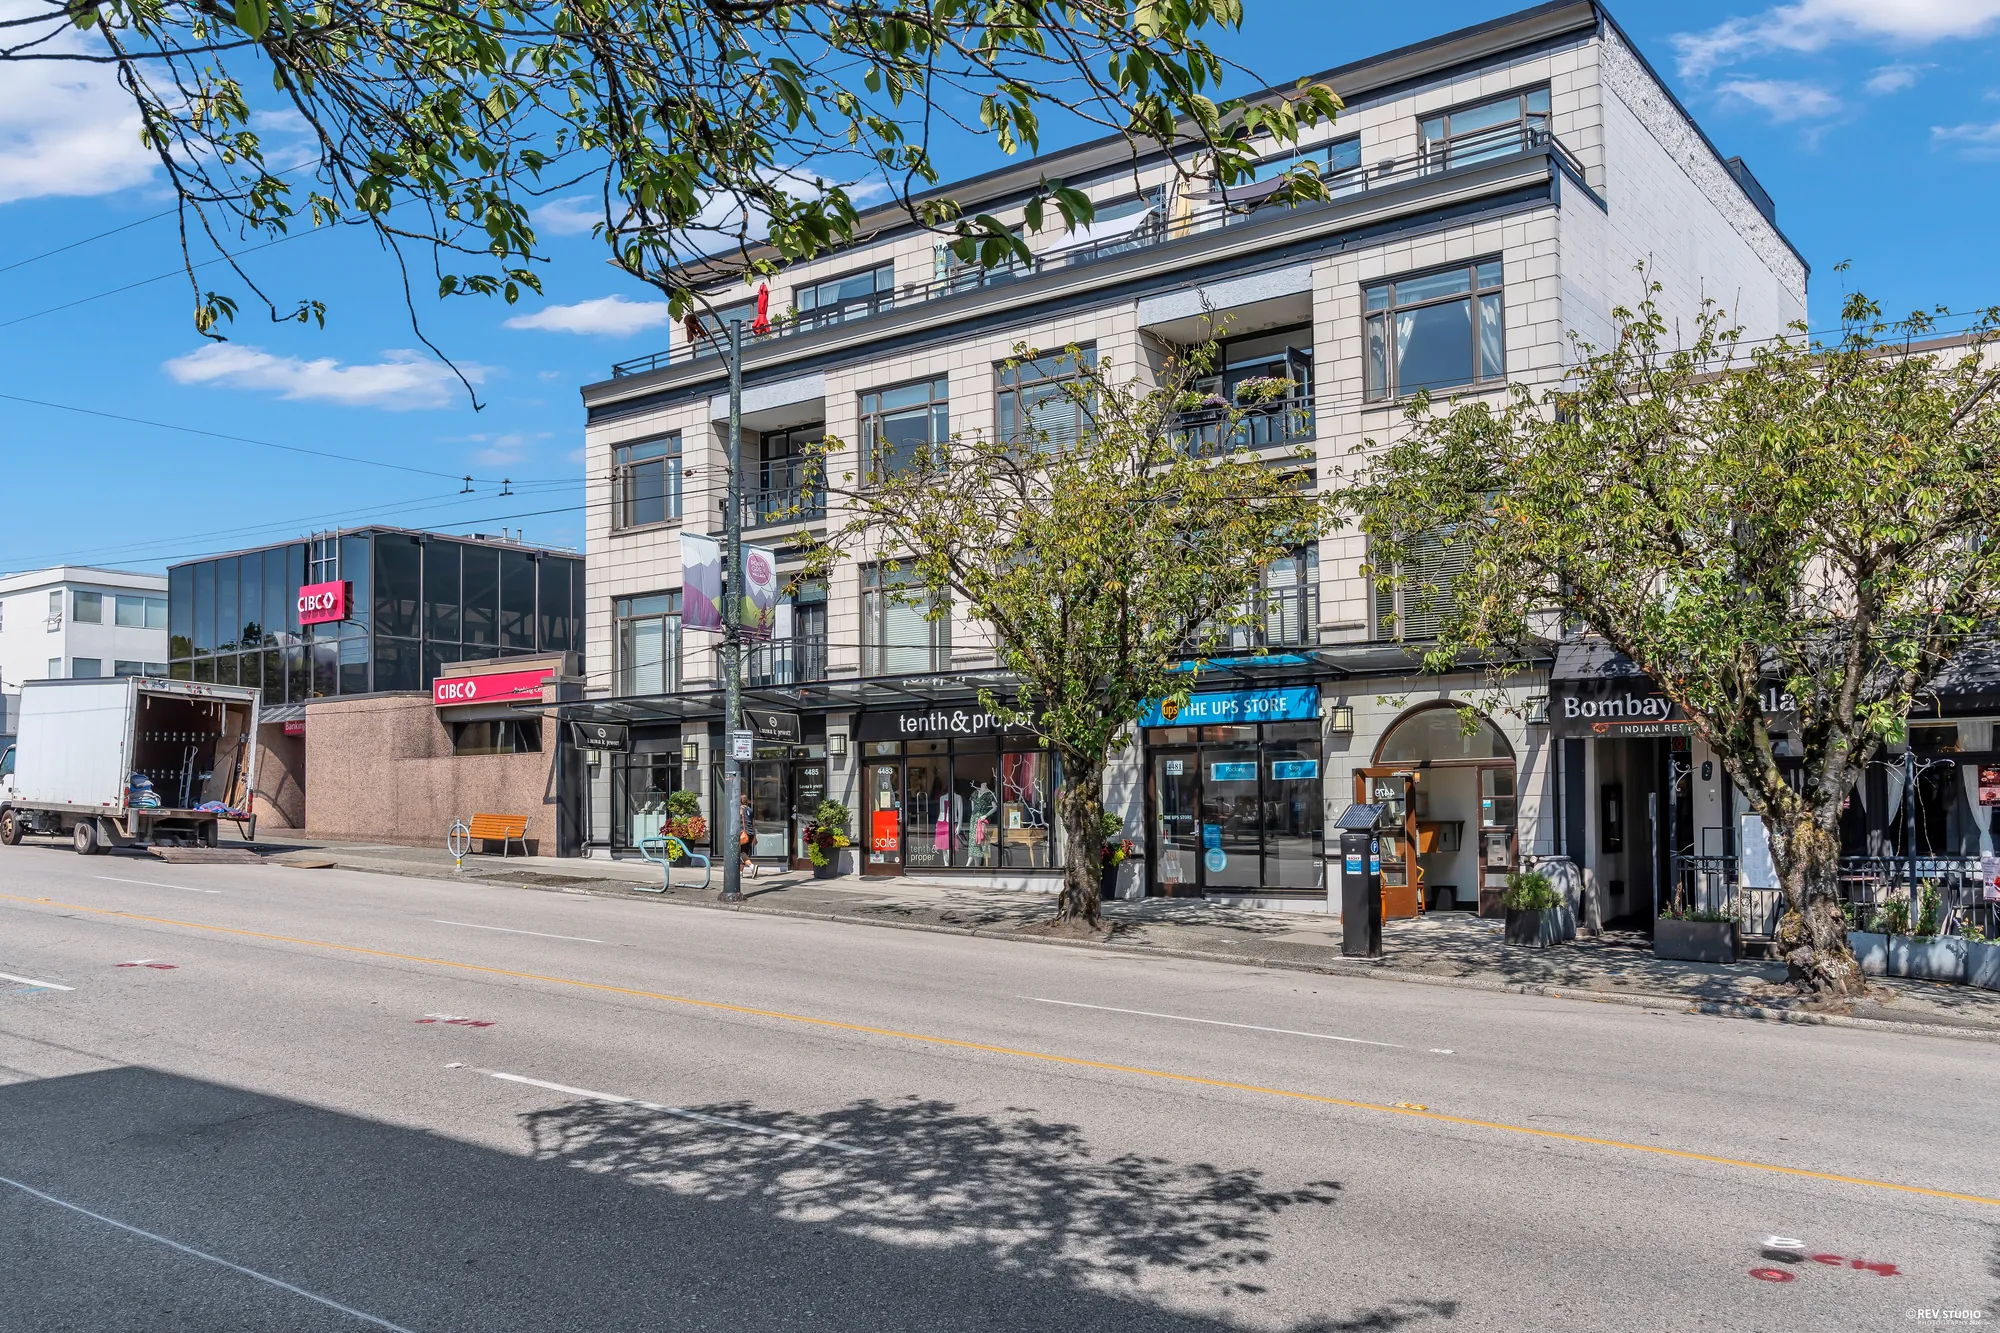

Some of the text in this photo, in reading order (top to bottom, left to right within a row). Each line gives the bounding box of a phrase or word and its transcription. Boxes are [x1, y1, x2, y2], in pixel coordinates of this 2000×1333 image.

[297, 594, 322, 612] CIBC
[438, 683, 464, 699] CIBC
[1163, 705, 1178, 718] ups
[1212, 701, 1239, 716] UPS
[1243, 697, 1287, 714] STORE
[1563, 693, 1672, 721] Bombay
[1620, 724, 1659, 734] INDIAN
[875, 829, 897, 848] sale
[910, 854, 935, 862] proper
